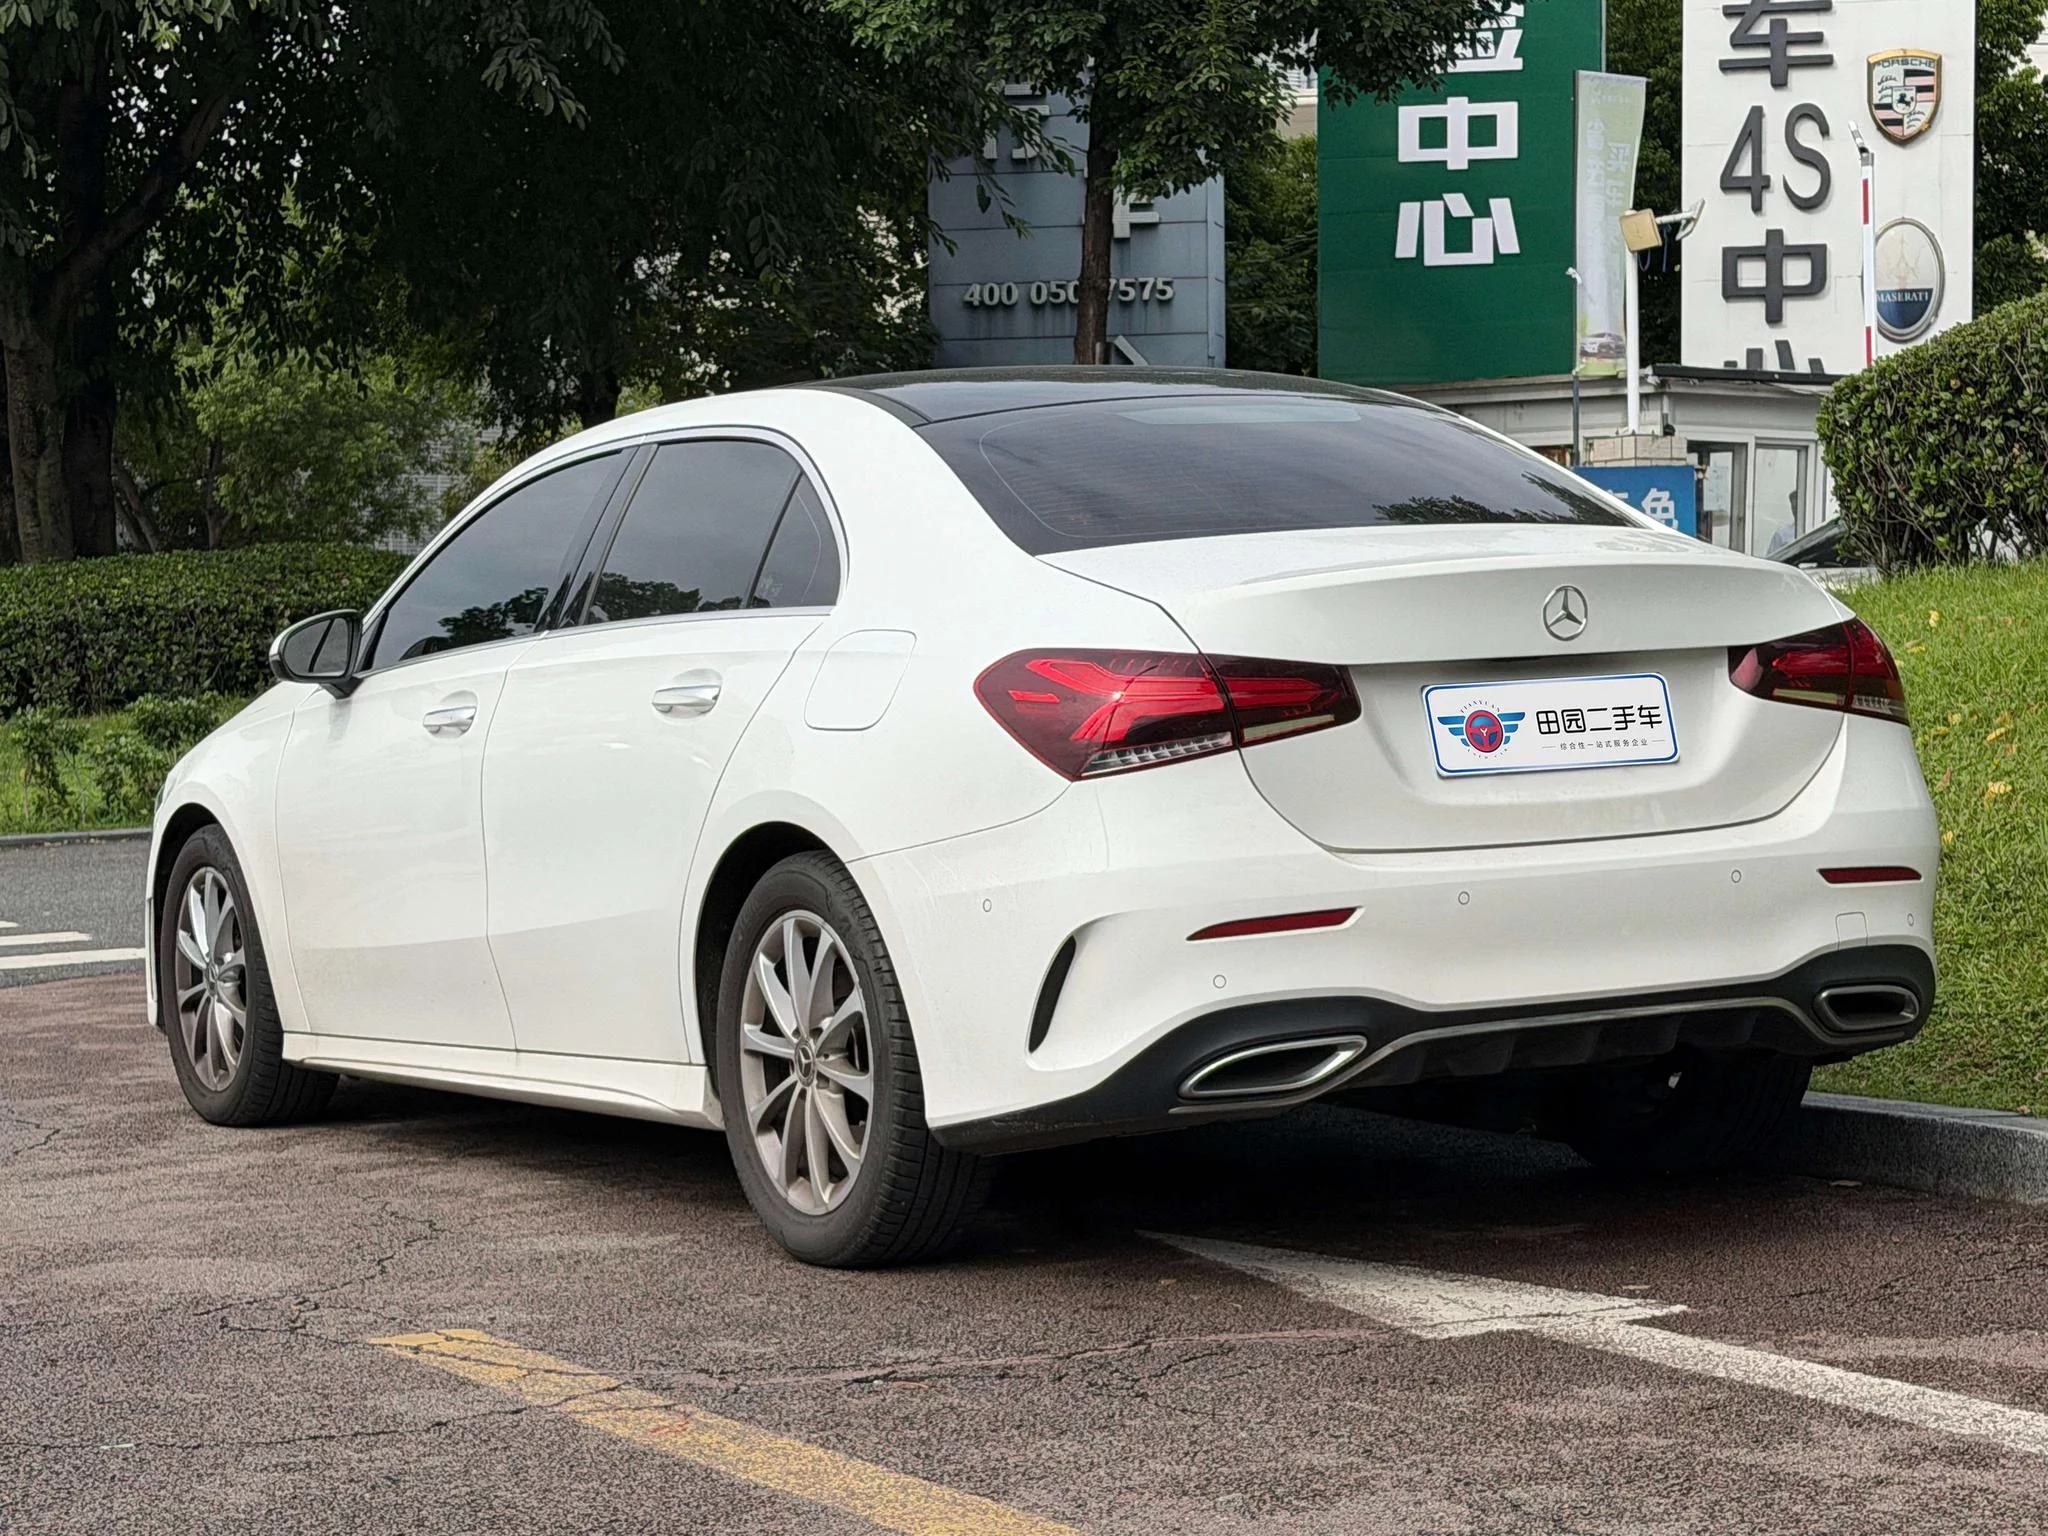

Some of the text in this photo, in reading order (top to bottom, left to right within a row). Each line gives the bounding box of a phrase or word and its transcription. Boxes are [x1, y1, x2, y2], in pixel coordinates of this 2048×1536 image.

[963, 282, 1018, 307] 400
[1876, 291, 1929, 303] MASERATI
[1536, 705, 1662, 734] 田园二手车
[1560, 738, 1648, 750] 综合性一站式服务企业
